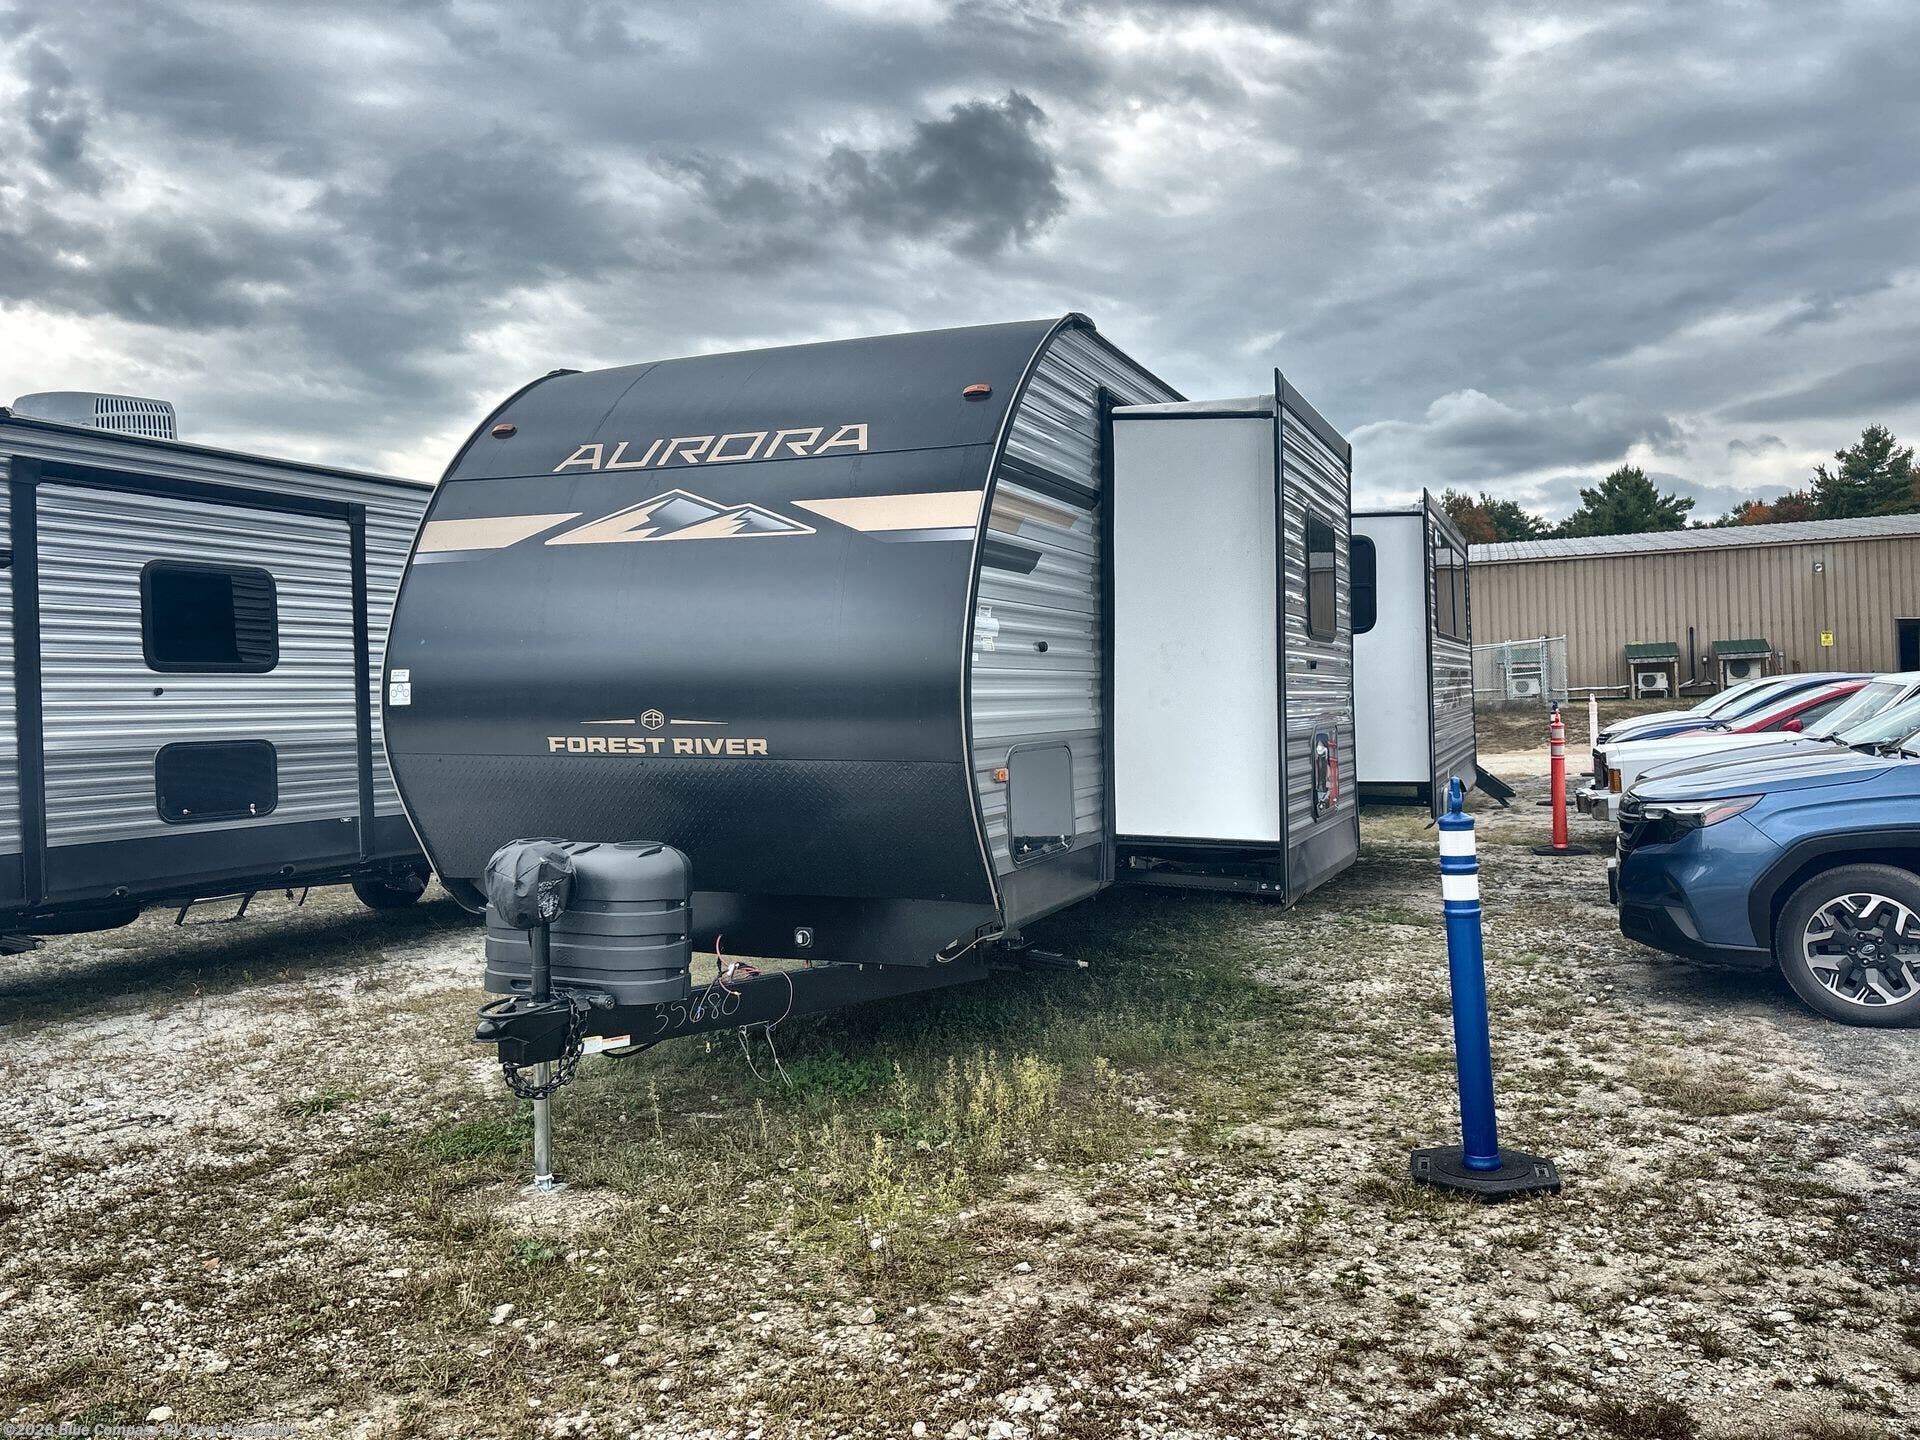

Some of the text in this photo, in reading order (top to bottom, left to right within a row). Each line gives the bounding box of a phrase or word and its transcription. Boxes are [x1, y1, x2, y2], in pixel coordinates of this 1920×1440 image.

[552, 423, 868, 472] AURORA
[546, 736, 769, 756] FOREST RIVER
